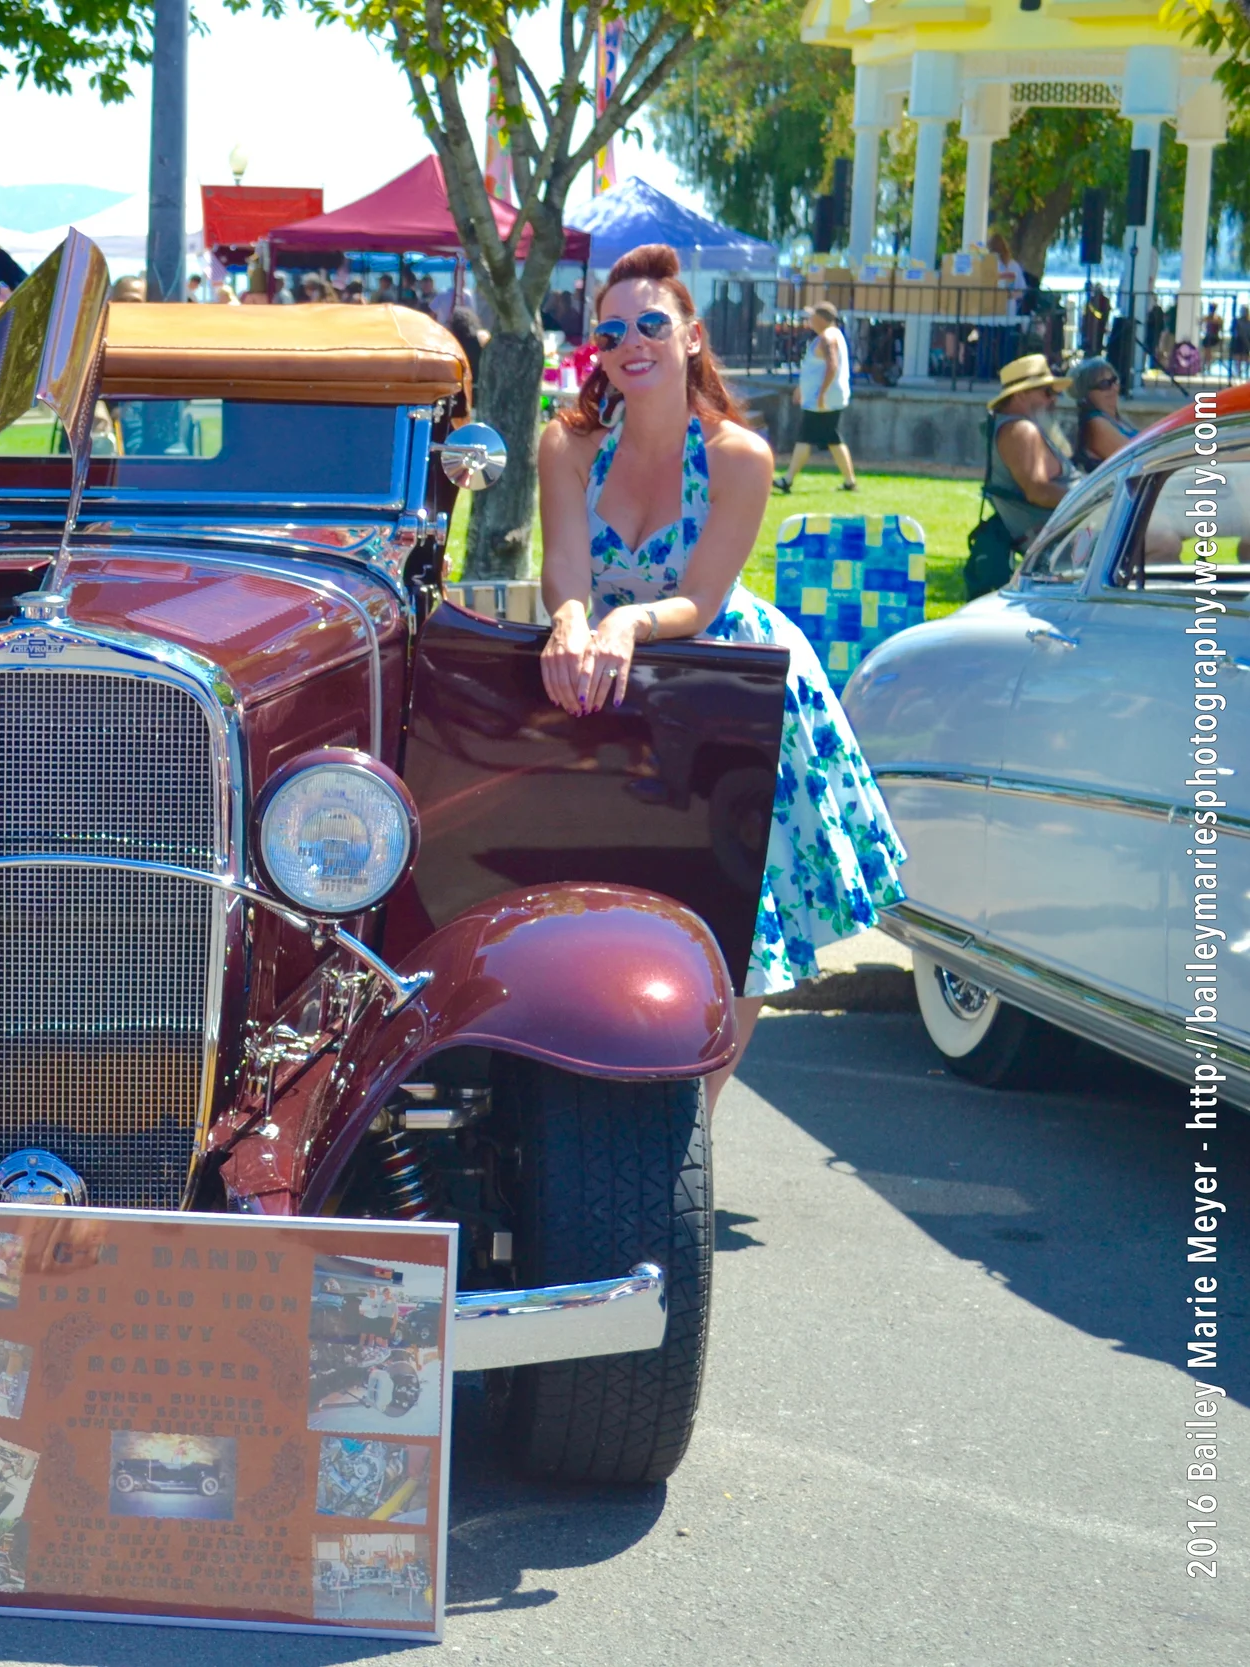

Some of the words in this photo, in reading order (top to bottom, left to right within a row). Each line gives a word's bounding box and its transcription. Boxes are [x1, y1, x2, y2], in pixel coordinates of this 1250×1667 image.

[13, 645, 62, 653] CHEVROLET
[152, 1245, 286, 1273] DANDY
[38, 1285, 107, 1304] 1931
[134, 1289, 195, 1308] OLD
[222, 1291, 298, 1312] IRON
[110, 1322, 215, 1343] CHEVY
[88, 1355, 260, 1381] ROADSTER
[171, 1392, 263, 1410] BUILDER
